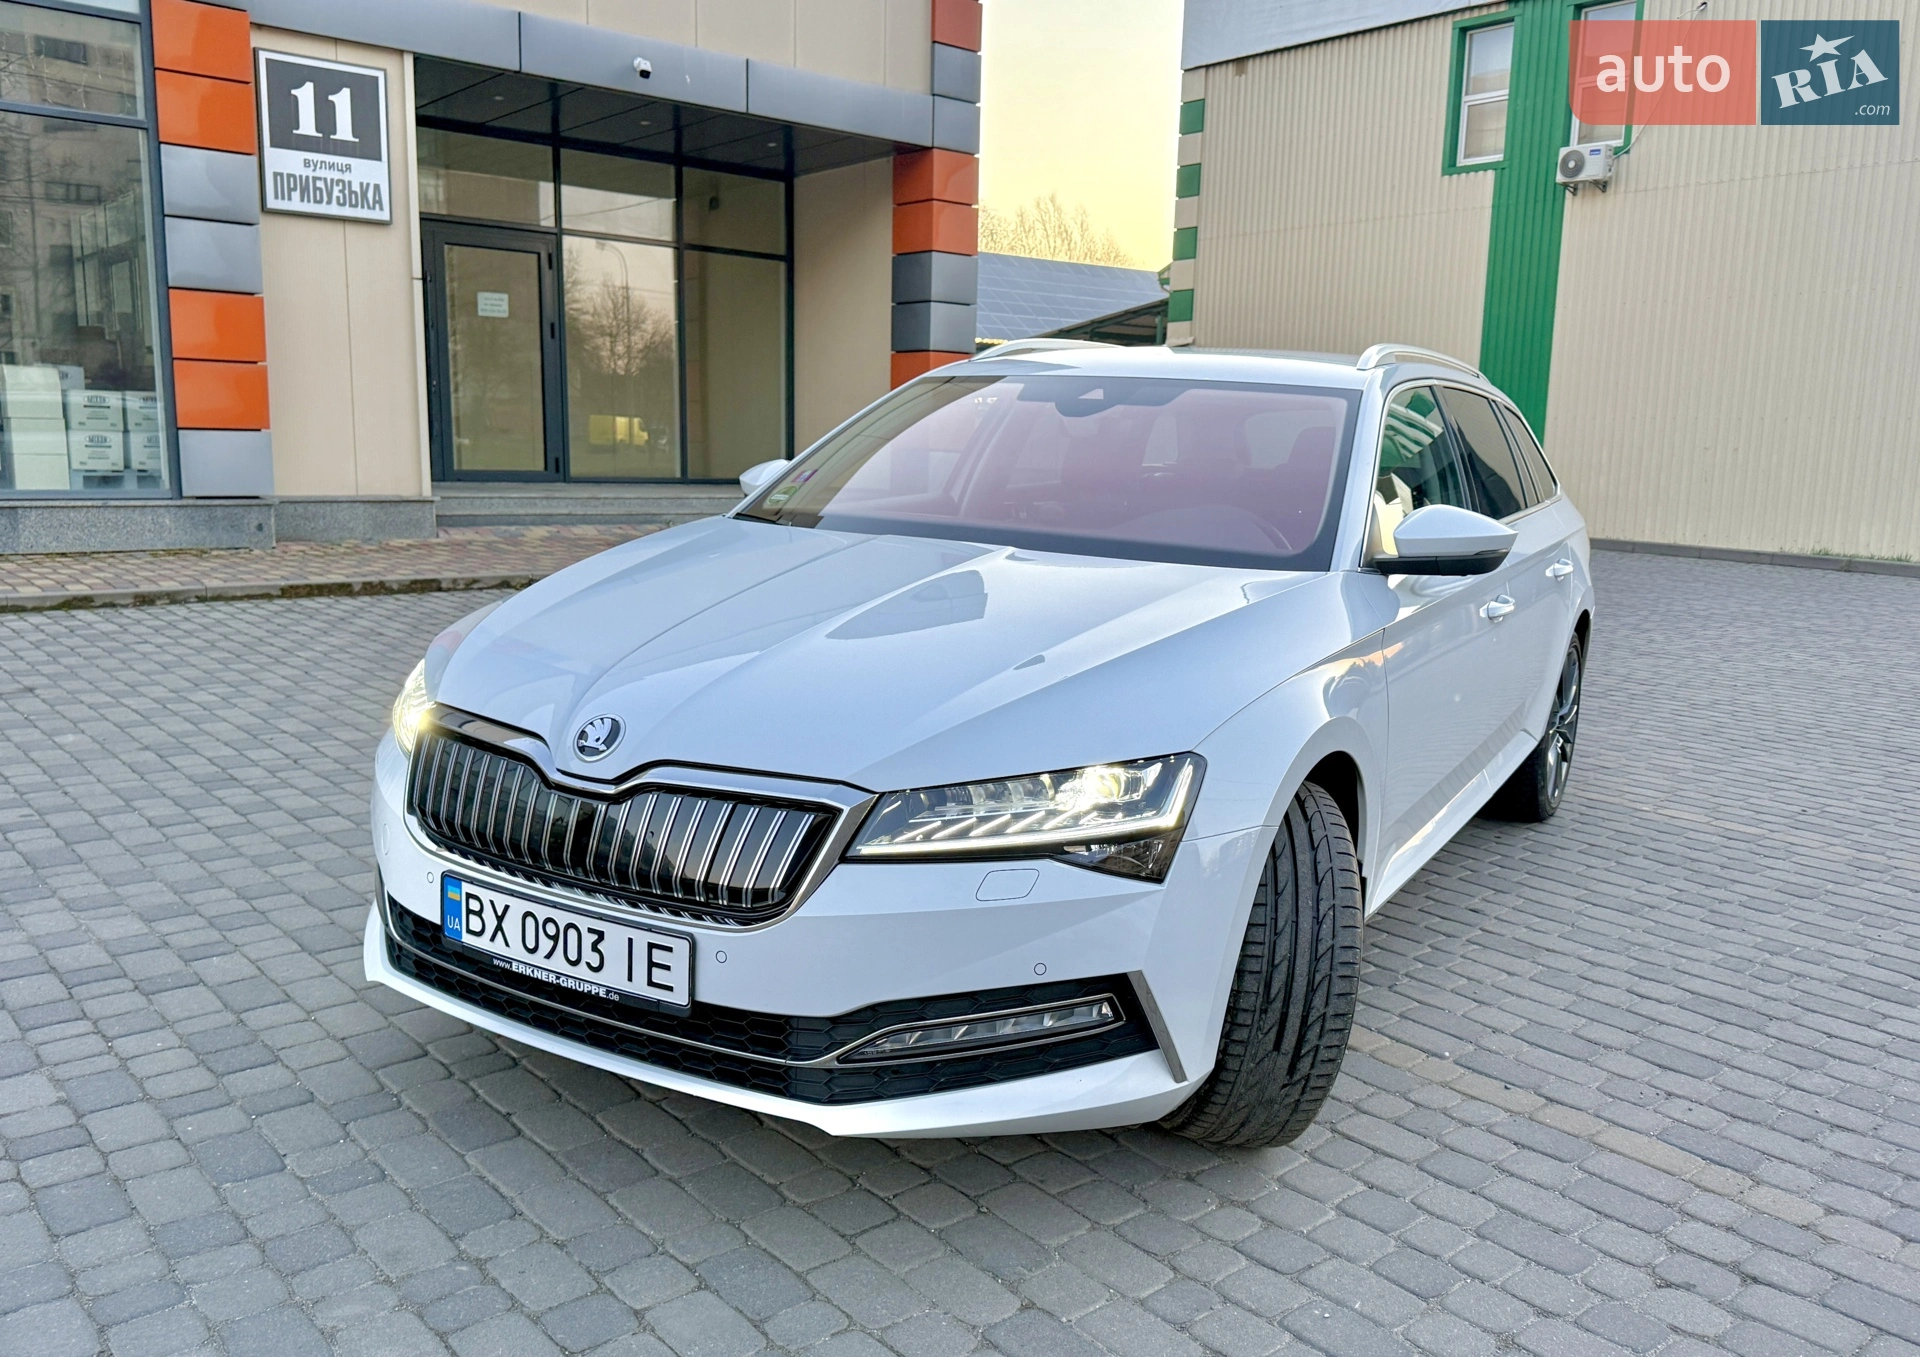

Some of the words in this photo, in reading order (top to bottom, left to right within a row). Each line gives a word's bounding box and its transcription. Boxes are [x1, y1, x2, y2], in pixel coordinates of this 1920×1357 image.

[290, 81, 359, 142] 11
[303, 157, 352, 174] вулиця
[272, 171, 385, 212] ПРИБУЗЬКА
[447, 915, 461, 932] UA
[465, 891, 511, 948] BX
[521, 911, 605, 973] 0903
[627, 936, 674, 992] IE
[493, 958, 620, 1001] www.ERKNER-GRUPPE.de
